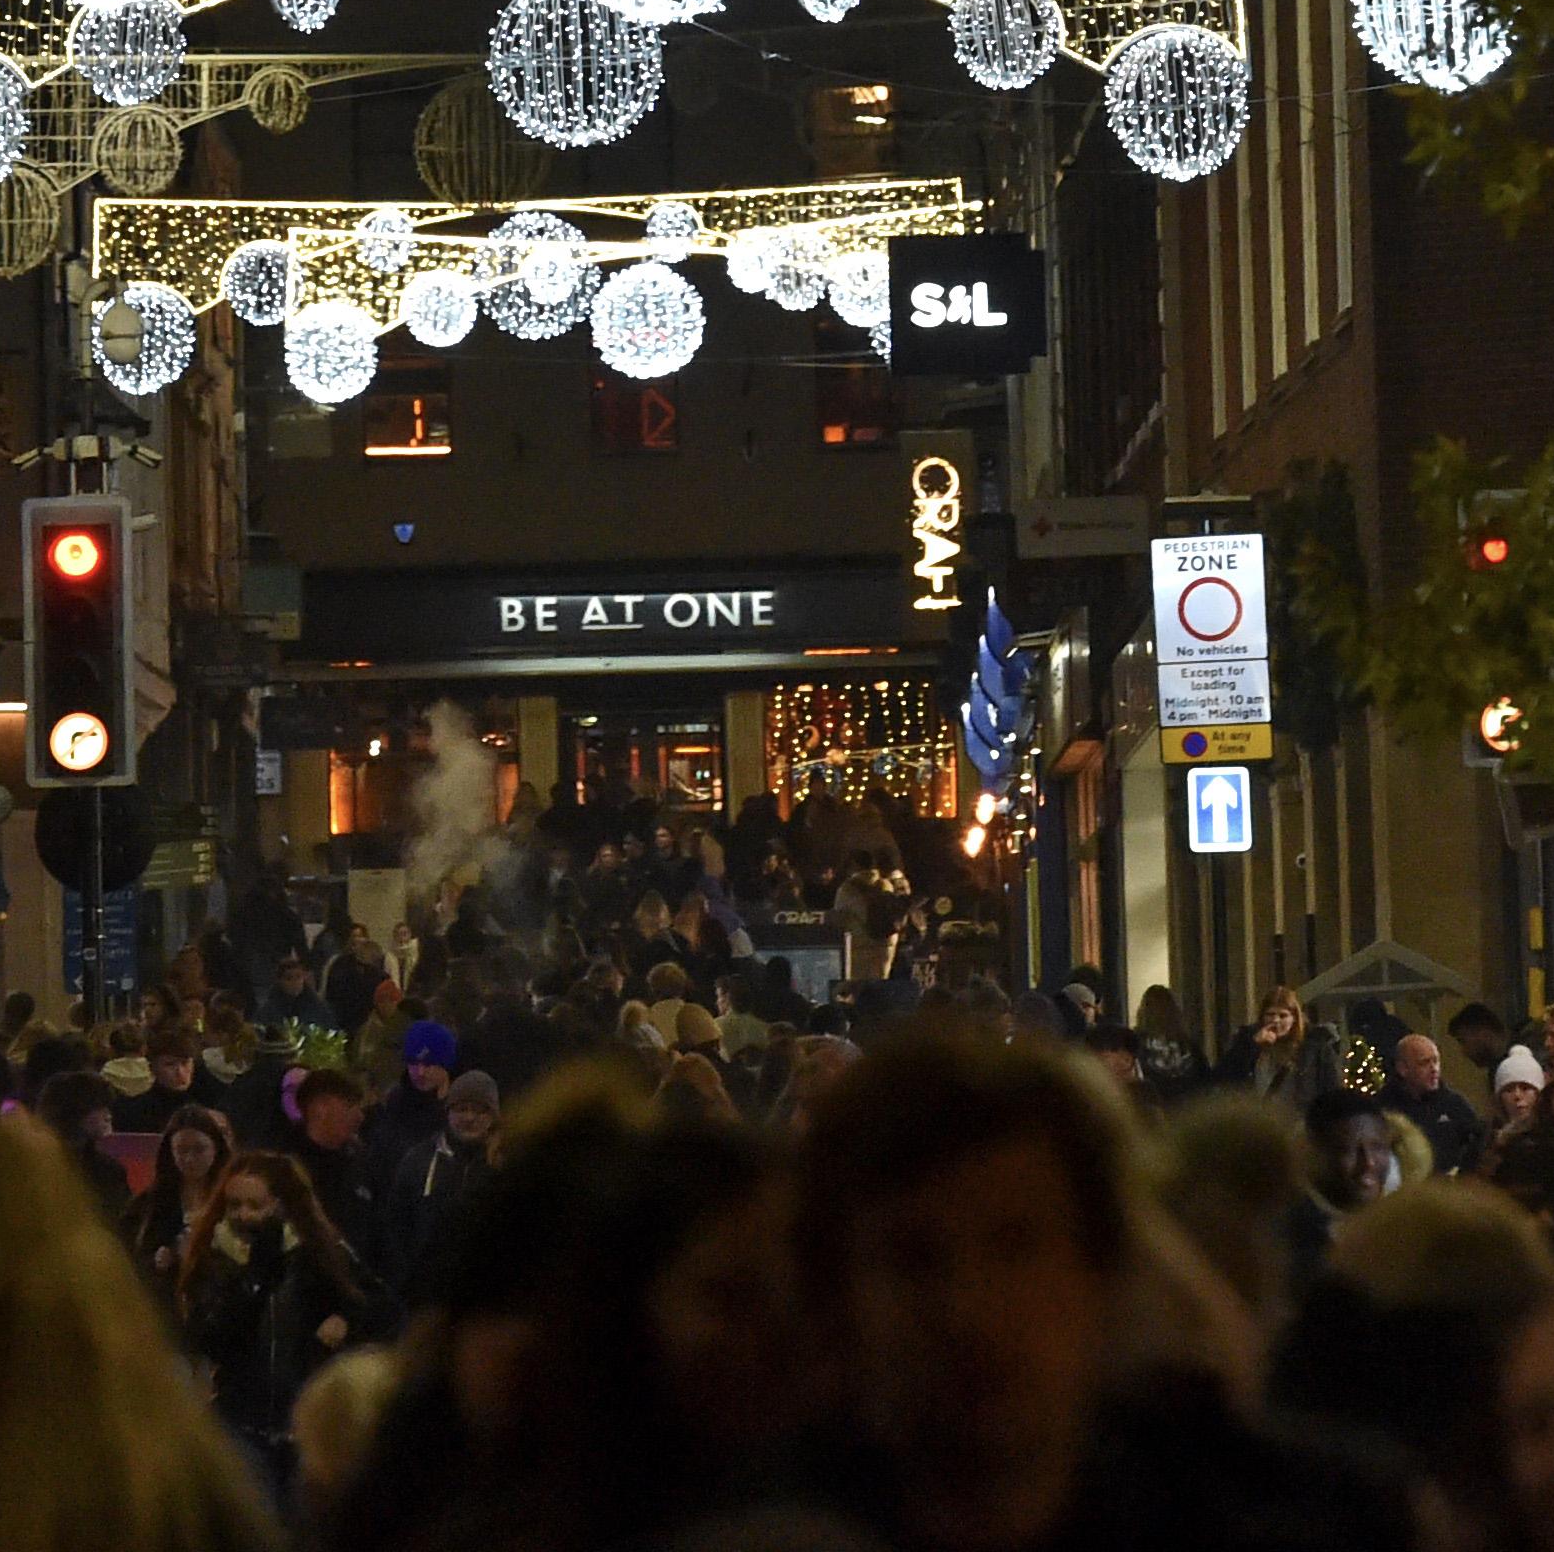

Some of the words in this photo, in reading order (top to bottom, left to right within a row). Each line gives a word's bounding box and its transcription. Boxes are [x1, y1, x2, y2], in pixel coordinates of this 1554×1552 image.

[1164, 540, 1251, 553] PEDESTRIAN
[1177, 553, 1238, 572] ZONE
[500, 597, 559, 632] BE
[581, 596, 645, 629] AT
[662, 591, 775, 628] ONE
[1176, 647, 1194, 657] No
[1198, 644, 1249, 656] vehicles
[1180, 667, 1224, 679] Except
[1228, 665, 1246, 677] for
[1190, 680, 1237, 692] loading
[1165, 696, 1219, 709] Midnight
[1229, 694, 1244, 706] 10
[1246, 696, 1265, 705] am
[1167, 710, 1177, 721] 4
[1179, 712, 1198, 722] pm
[1208, 707, 1264, 720] Midnight
[1212, 731, 1225, 741] At
[1229, 731, 1252, 742] any
[1218, 744, 1246, 755] time
